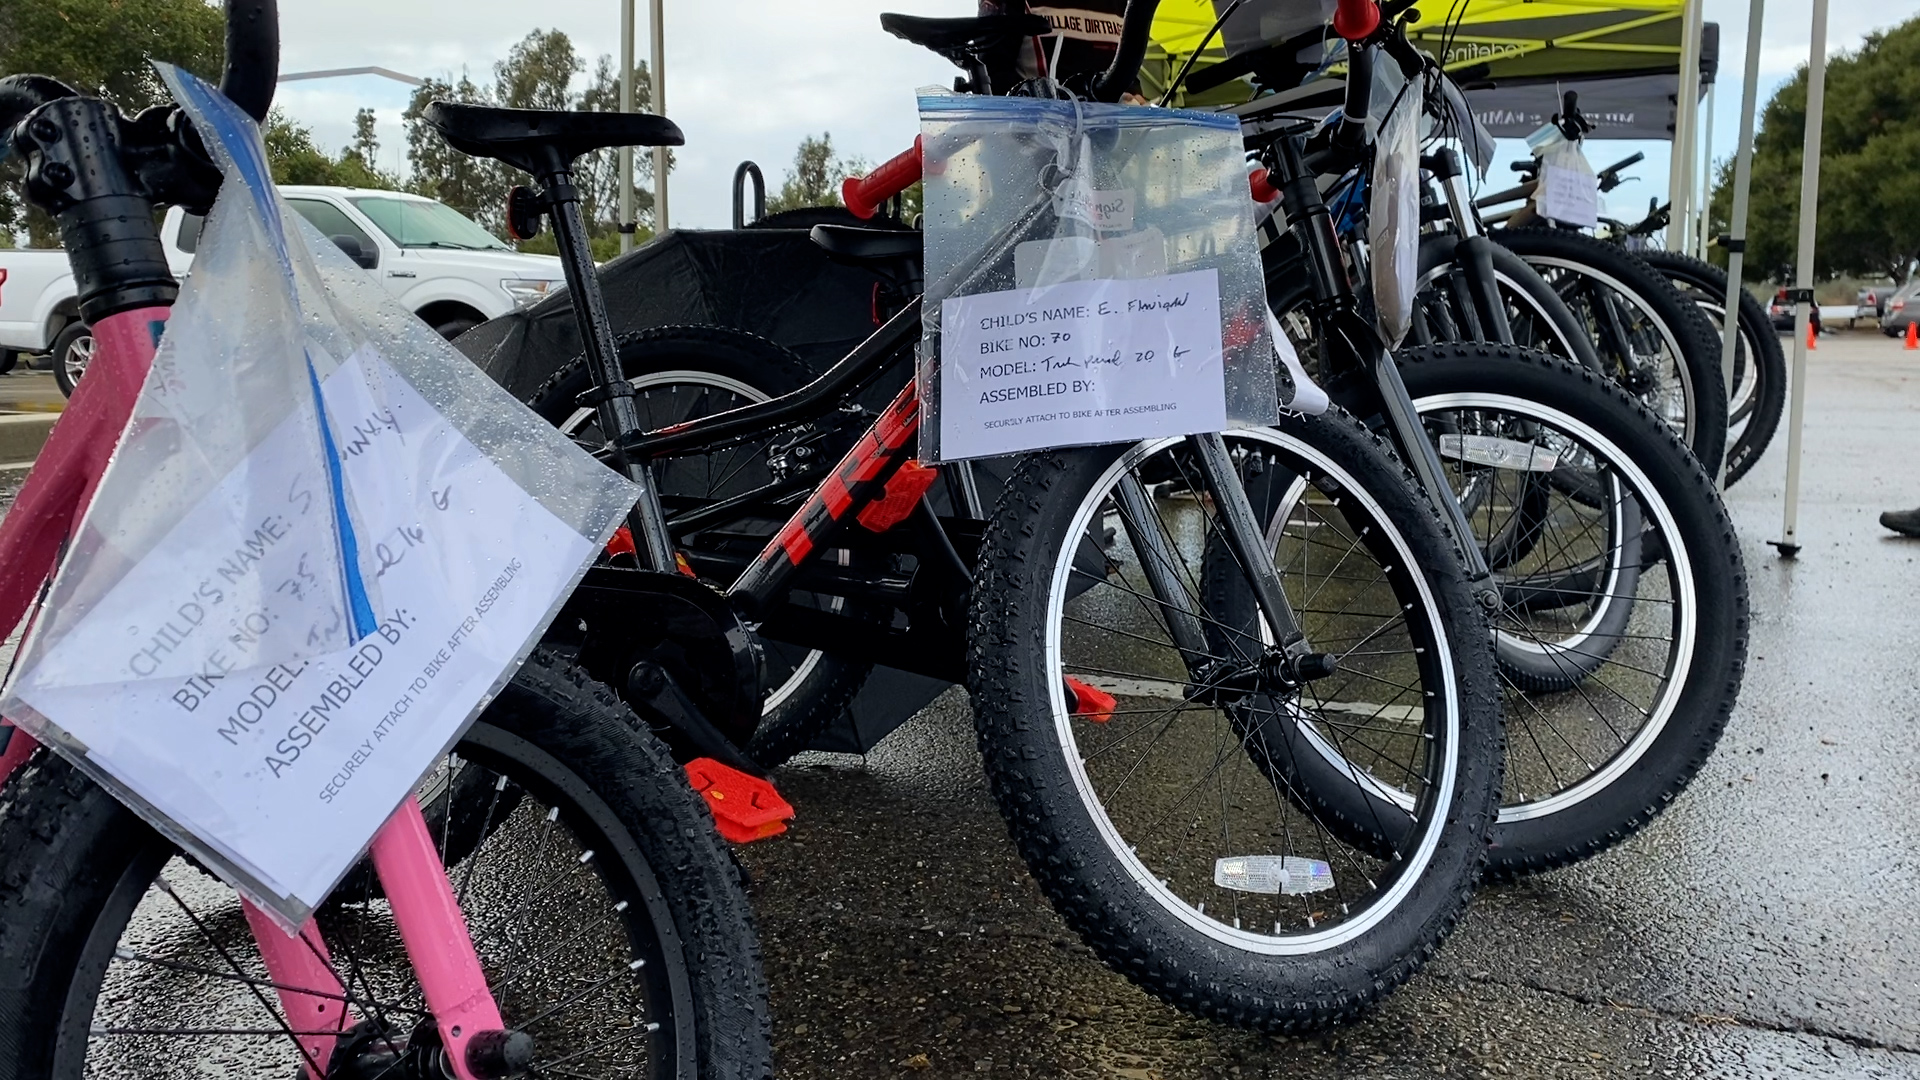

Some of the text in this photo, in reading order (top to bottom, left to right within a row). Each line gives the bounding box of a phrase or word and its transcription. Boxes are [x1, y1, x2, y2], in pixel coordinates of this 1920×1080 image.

[1044, 15, 1082, 32] ILLAGE
[980, 312, 1037, 331] CHILD'S
[1042, 305, 1090, 322] NAME:
[980, 332, 1072, 355] BIKE NO: 70
[979, 379, 1096, 405] ASSEMBLED BY:
[980, 360, 1037, 380] MODEL:
[1135, 350, 1156, 363] 20
[984, 402, 1177, 431] SECURELY ATTACH TO BIKE AFTER ASSEMBLING
[761, 378, 922, 566] TRE
[129, 577, 225, 678] CHILD'S
[216, 515, 292, 586] NAME:
[171, 648, 238, 714] BIKE
[228, 606, 280, 654] NO:
[318, 556, 523, 805] SECURELY ATTACH TO BIKE AFTER ASSEMBLING
[216, 653, 311, 747] MODEL:
[264, 607, 418, 779] ASSEMBLED BY:
